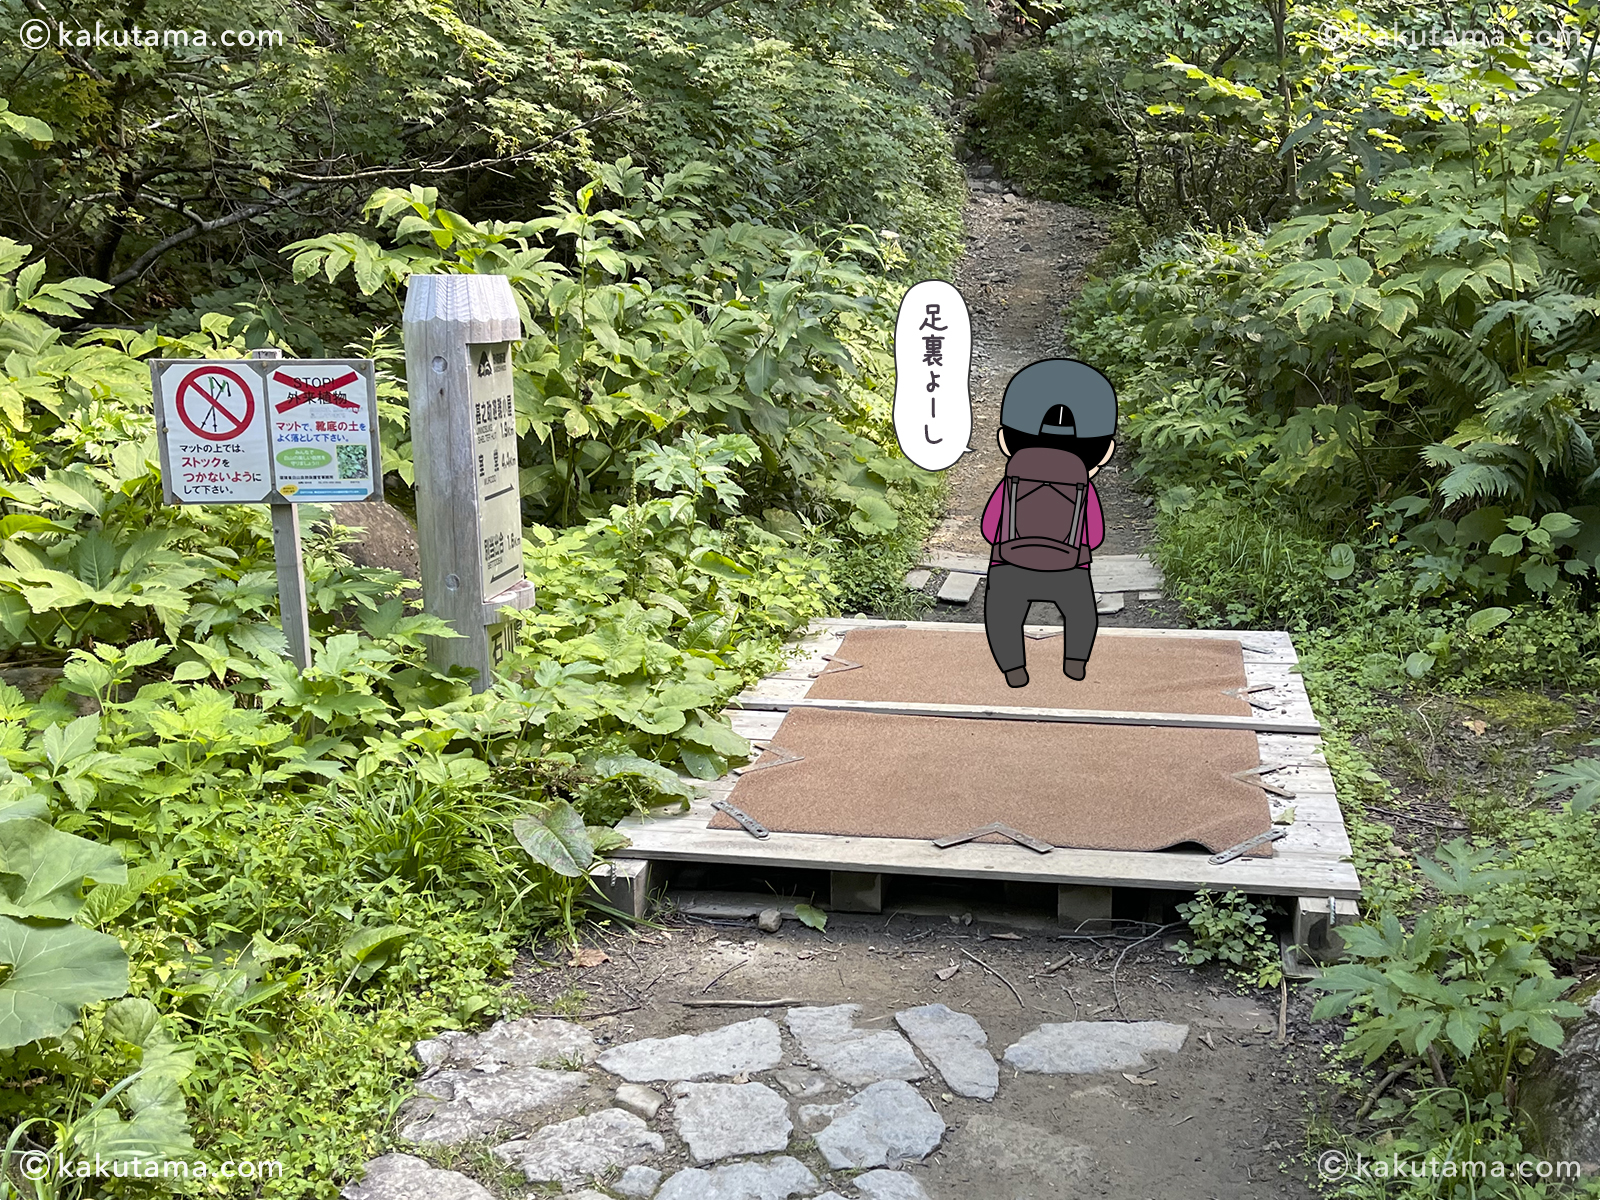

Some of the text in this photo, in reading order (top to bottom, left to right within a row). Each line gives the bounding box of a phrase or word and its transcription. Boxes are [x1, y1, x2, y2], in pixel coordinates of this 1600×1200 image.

[287, 390, 347, 405] 外来植物
[275, 420, 367, 432] マットで、靴底の土を
[276, 433, 349, 443] よく落として下さい。
[179, 443, 245, 454] マットの上では、
[181, 456, 230, 468] ストックを
[183, 471, 262, 483] つかないように
[183, 484, 234, 495] して下さい。
